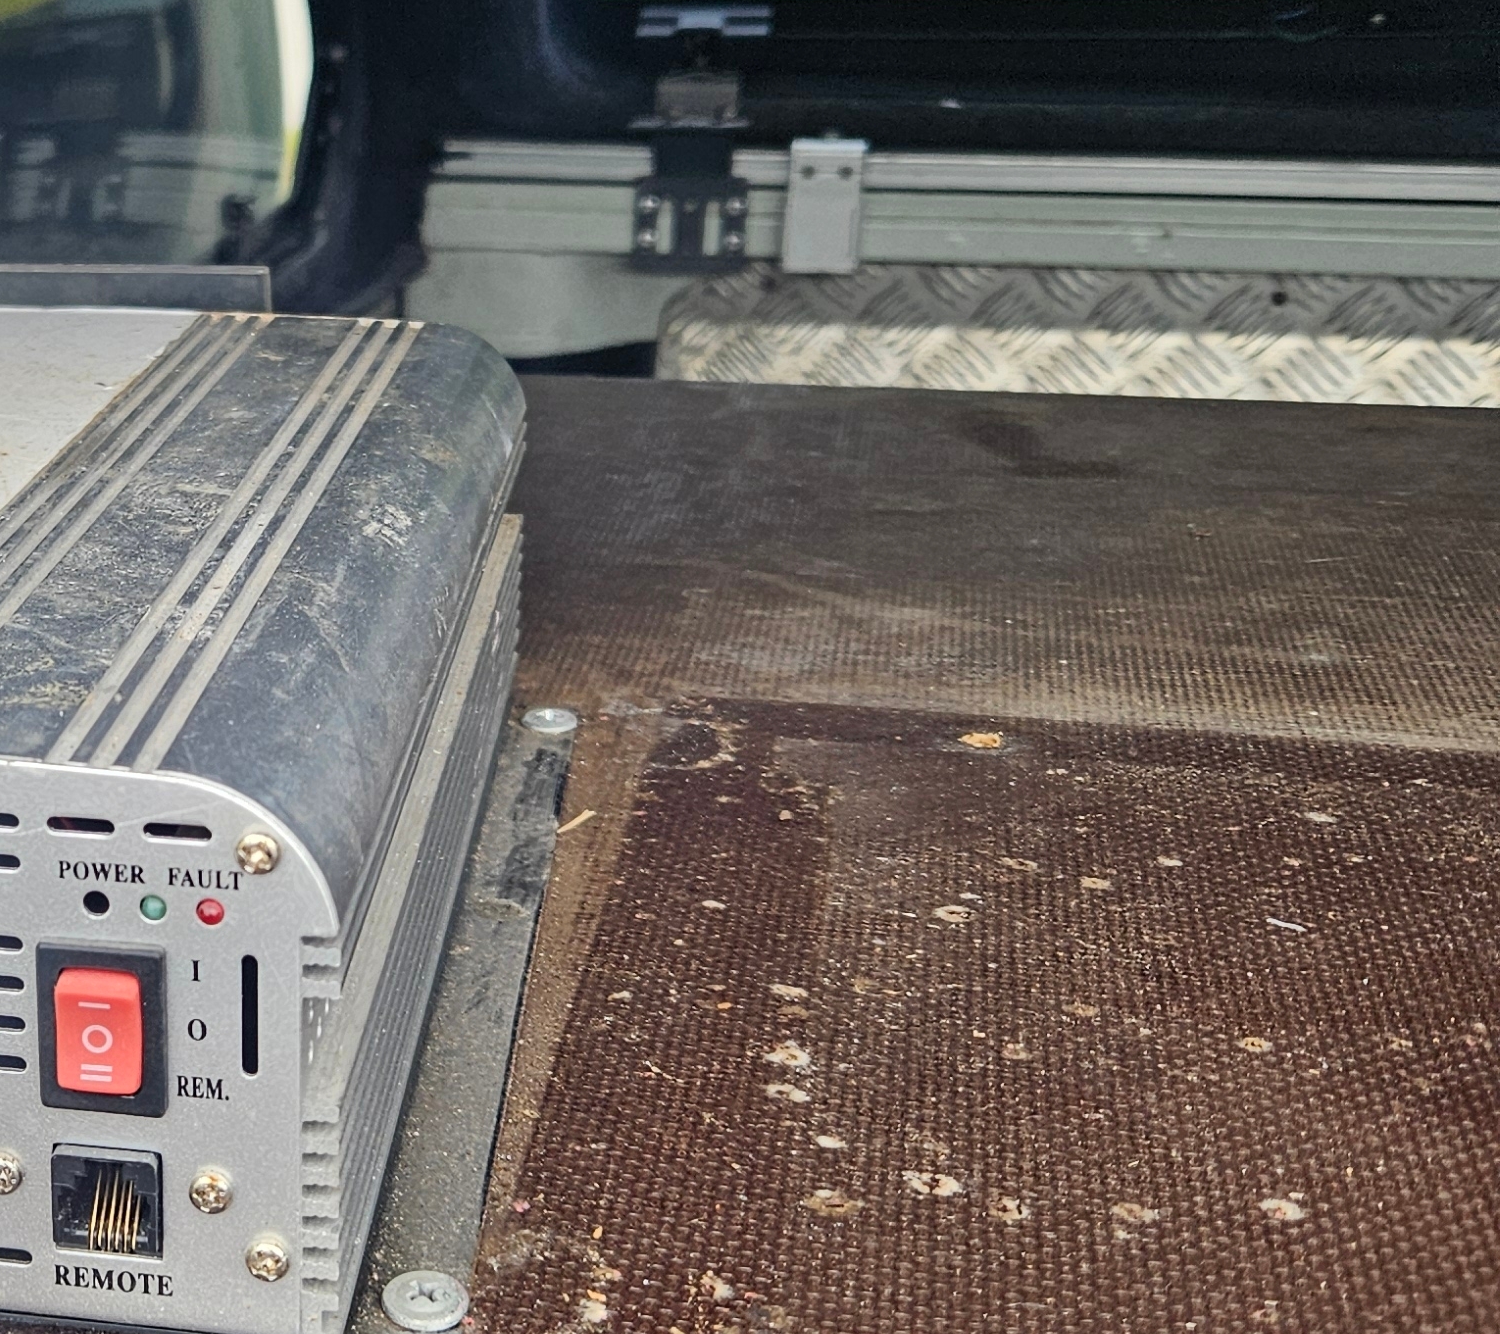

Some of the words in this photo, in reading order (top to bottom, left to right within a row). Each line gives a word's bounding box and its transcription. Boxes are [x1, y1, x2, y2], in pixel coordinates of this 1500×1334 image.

[58, 860, 145, 884] POWER
[168, 867, 243, 890] FAULT
[176, 1075, 230, 1101] REM.
[54, 1264, 174, 1296] REMOTE
